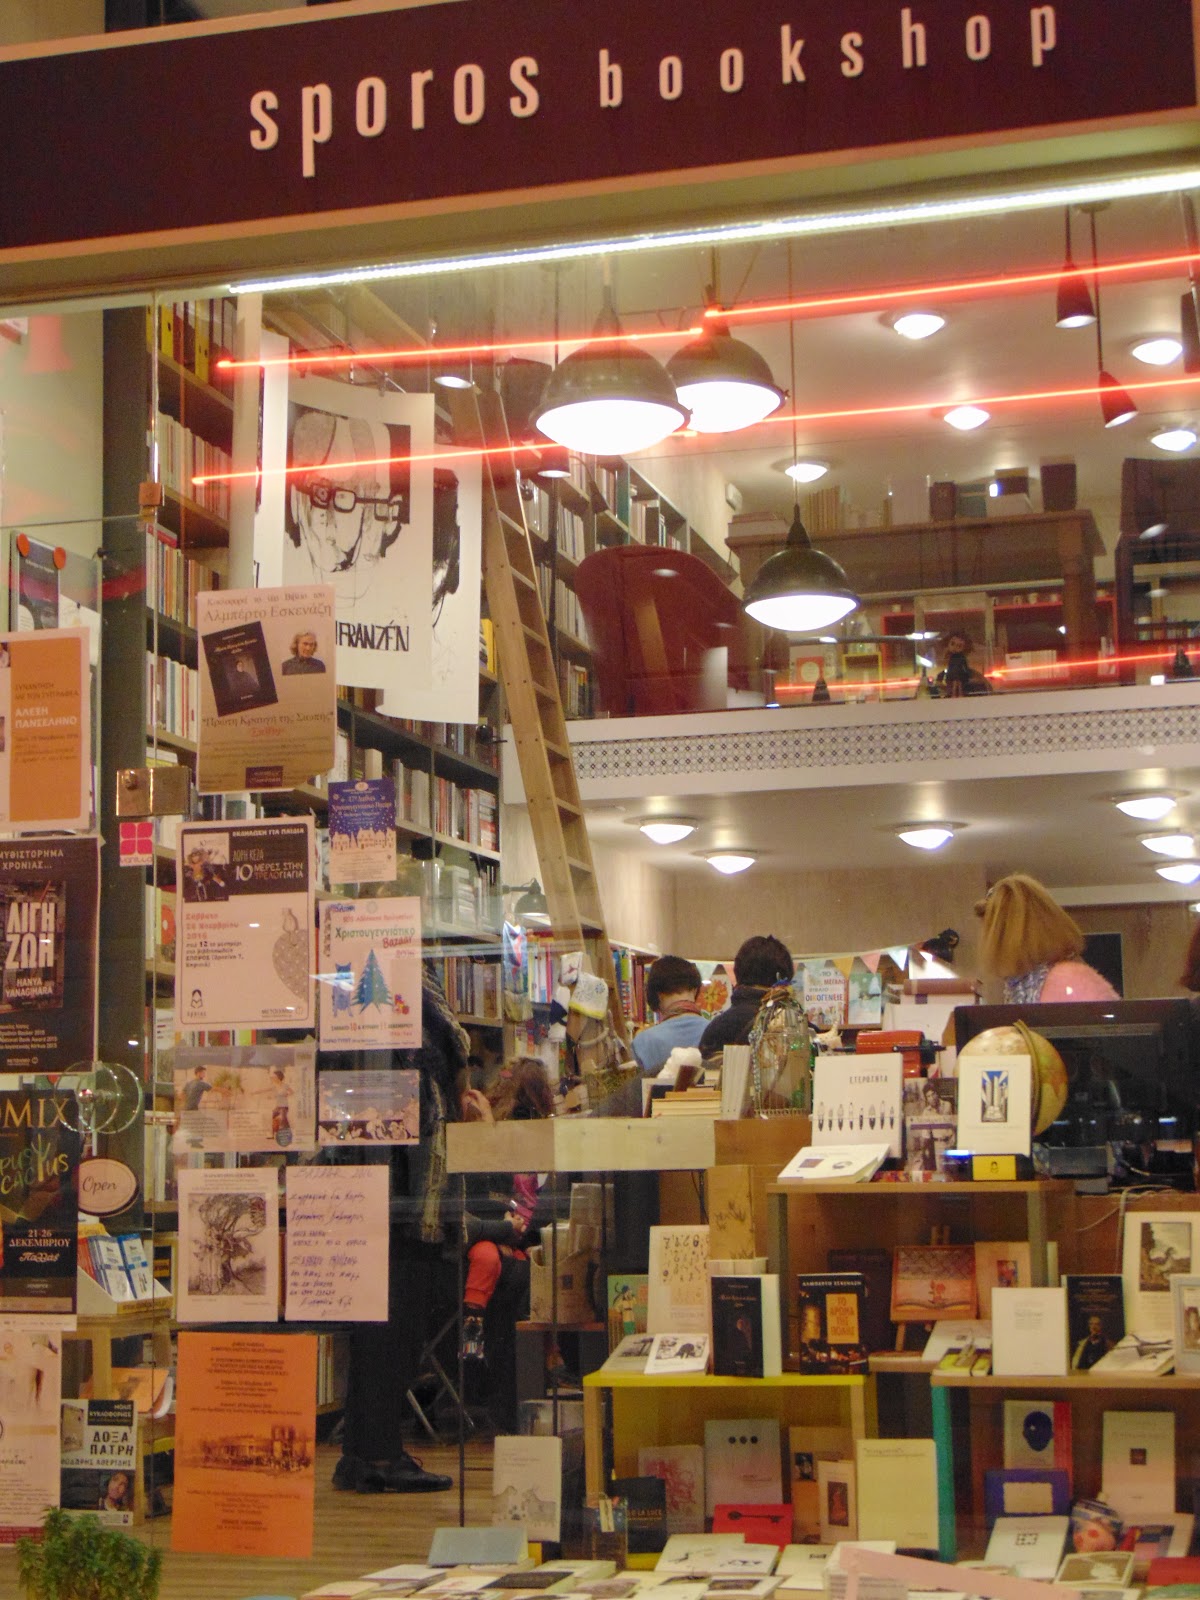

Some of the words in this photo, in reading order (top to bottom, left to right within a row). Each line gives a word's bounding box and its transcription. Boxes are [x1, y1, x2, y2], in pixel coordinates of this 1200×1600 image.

[249, 57, 541, 178] sporos
[599, 5, 1057, 108] bookshop
[270, 602, 332, 618] Εσκενάζη
[6, 902, 56, 933] ΛΙΓΗ
[5, 932, 55, 970] ΖΩΗ
[16, 978, 42, 987] HANYA
[5, 986, 53, 998] YANAGIHARA
[0, 1098, 70, 1128] MIX
[82, 1176, 118, 1192] Open
[9, 1238, 71, 1247] ΔΕΚΕΜΒΡΙΟΥ
[93, 1431, 129, 1443] ΔΟΞΑ
[90, 1444, 134, 1456] ΠΑΤΡΗ
